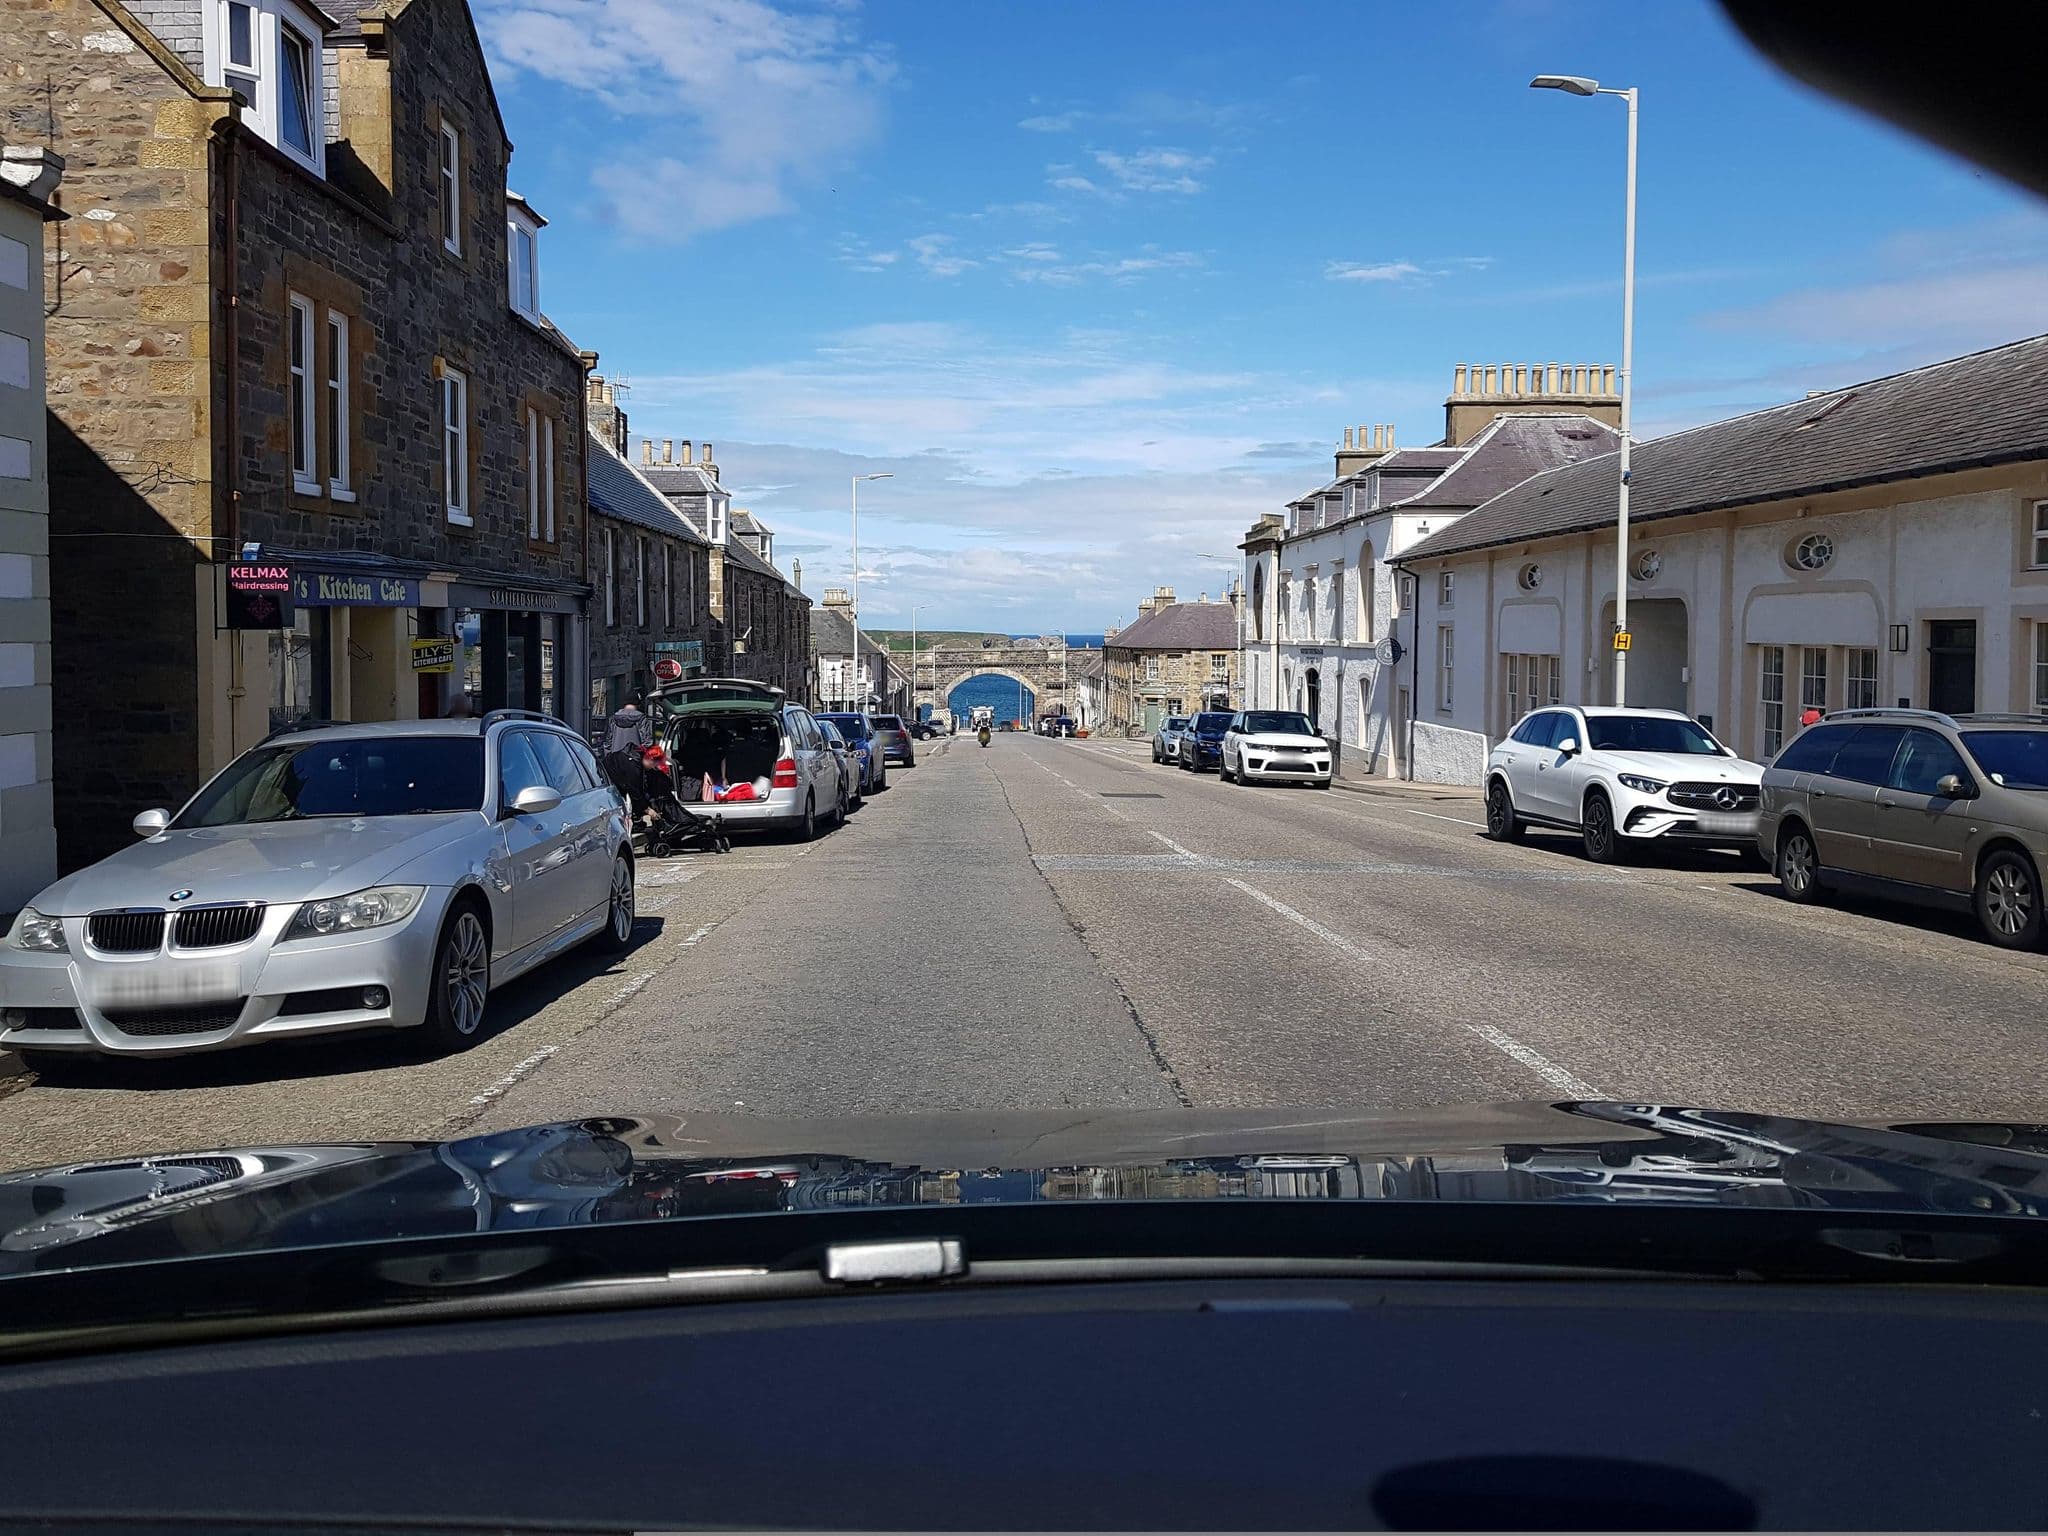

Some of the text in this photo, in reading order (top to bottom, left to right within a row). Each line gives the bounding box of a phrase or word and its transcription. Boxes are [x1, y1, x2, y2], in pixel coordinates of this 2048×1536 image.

[231, 567, 289, 578] KELMAX
[232, 582, 289, 592] Hairdressing
[319, 575, 372, 600] Kitchen
[381, 579, 406, 601] Cafe
[1616, 634, 1629, 649] H
[413, 644, 453, 660] LILY'S
[413, 658, 438, 667] KITCHEN
